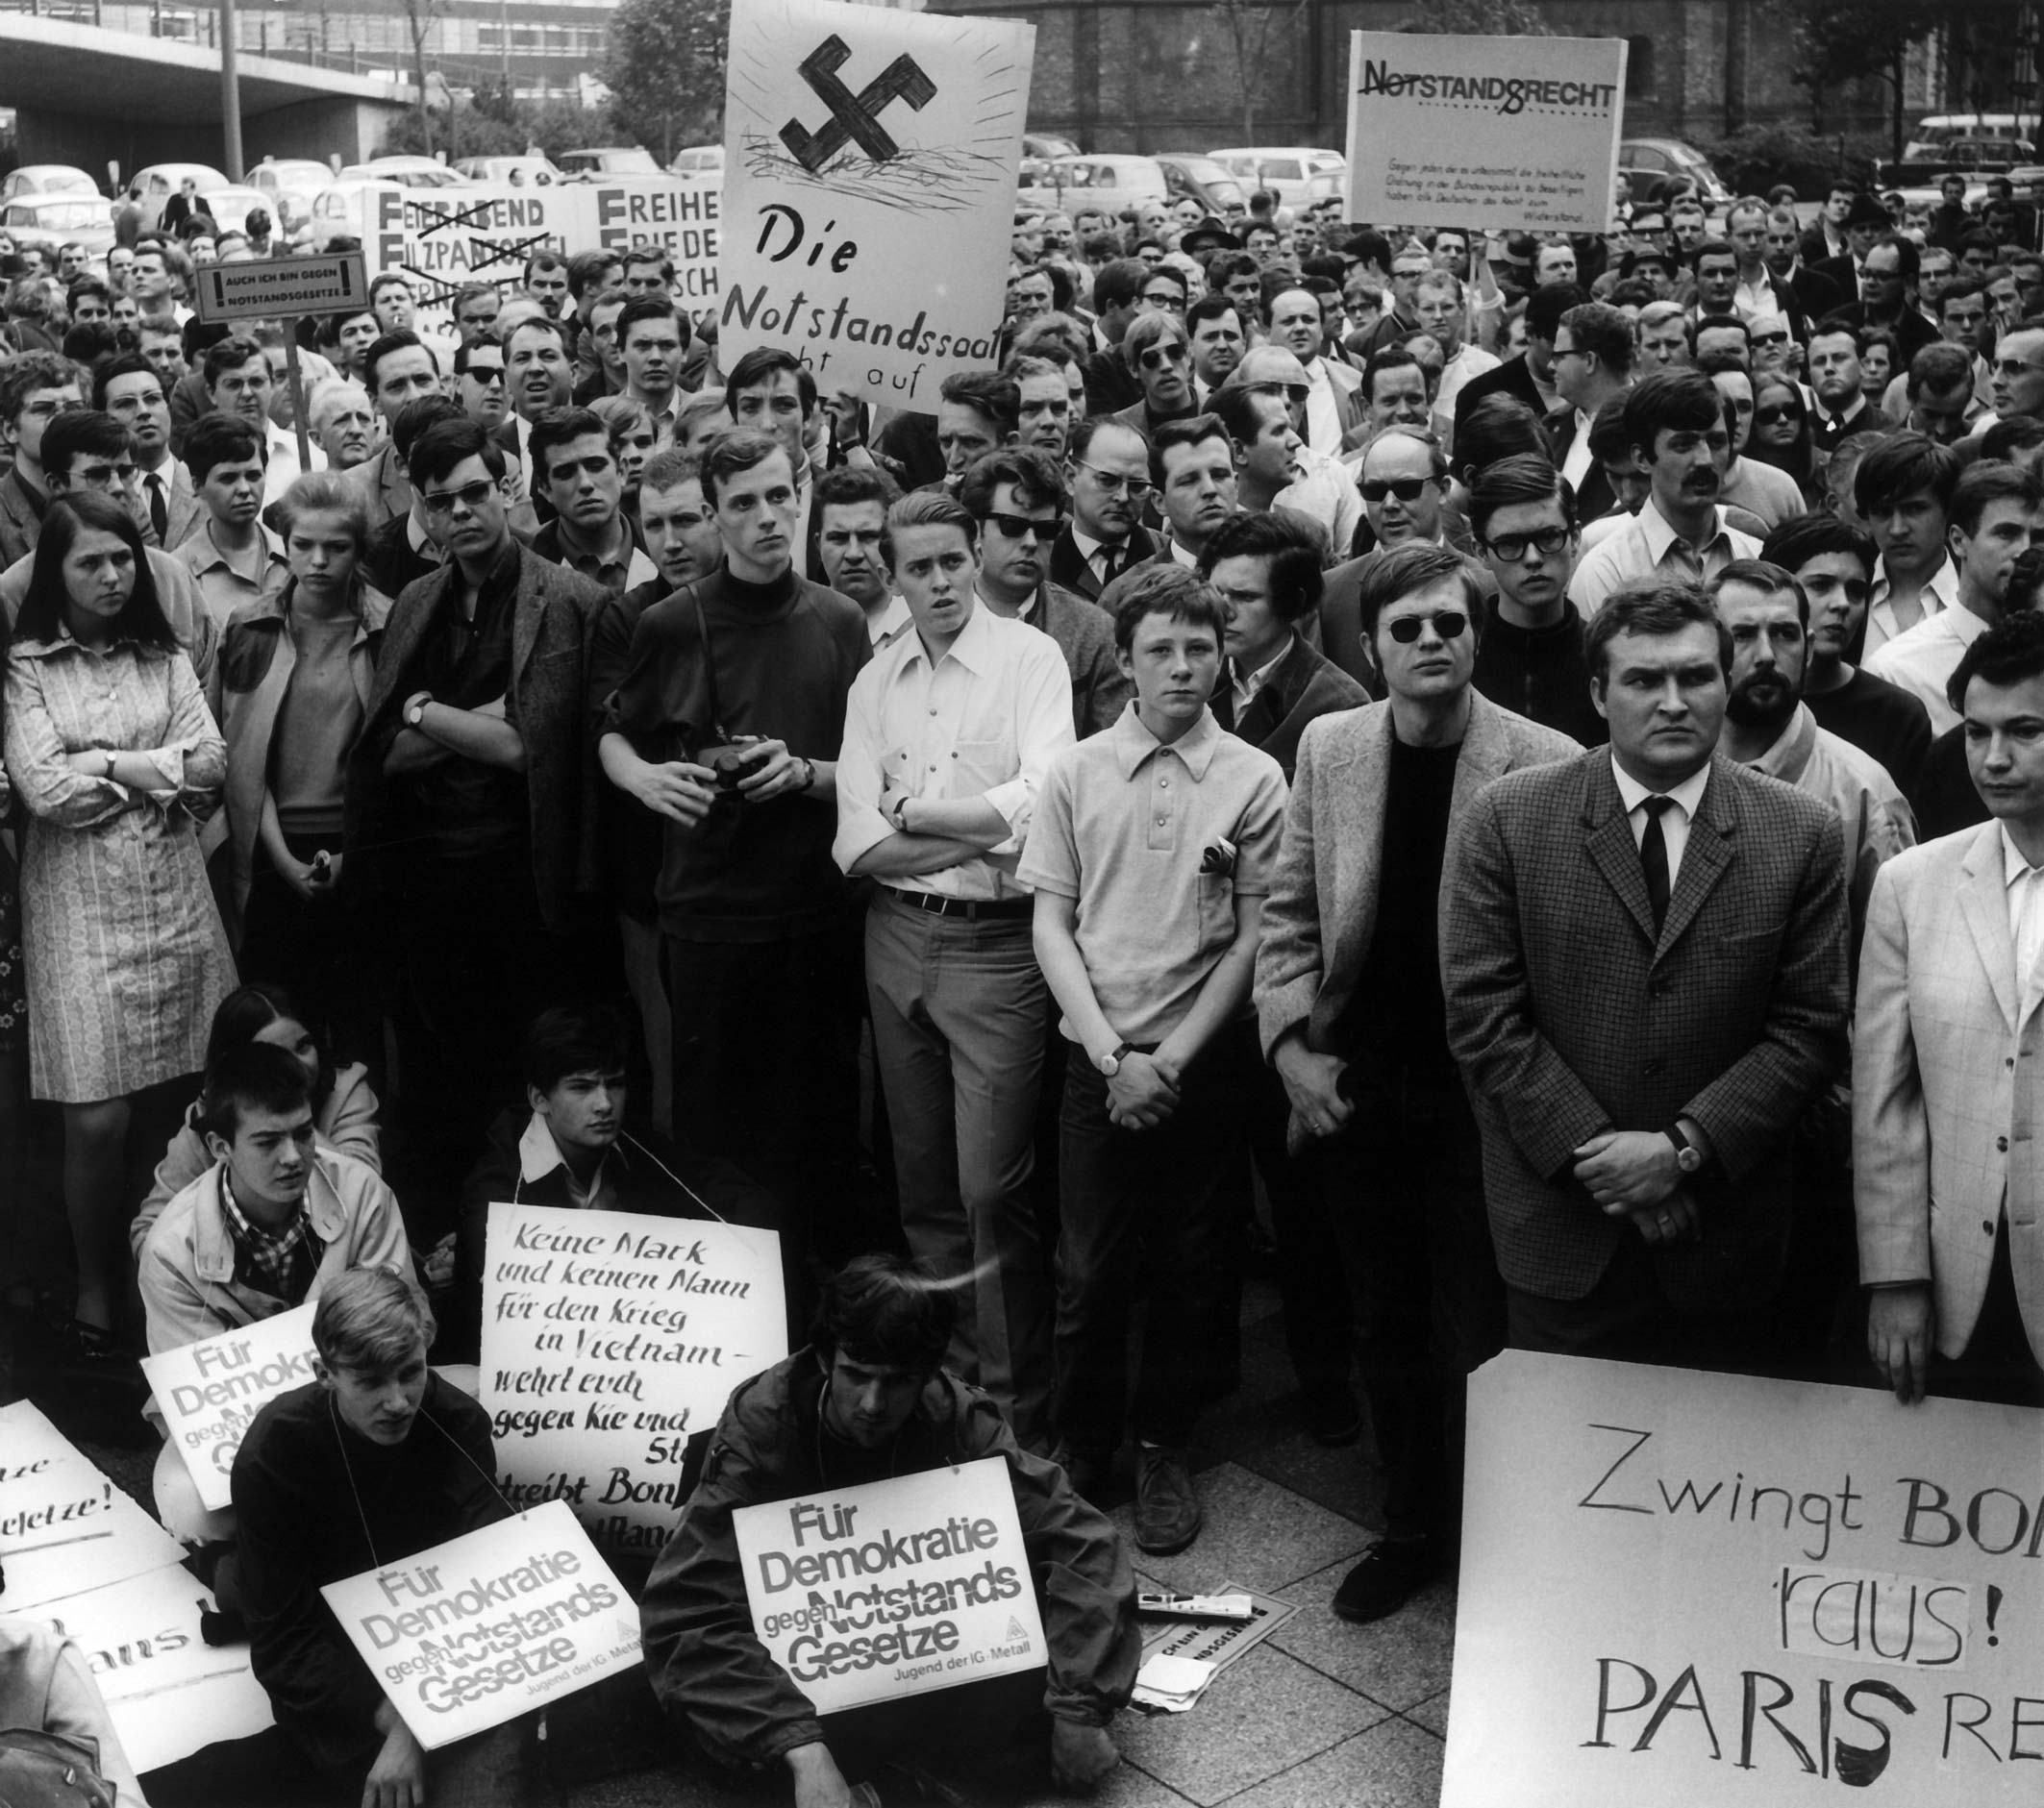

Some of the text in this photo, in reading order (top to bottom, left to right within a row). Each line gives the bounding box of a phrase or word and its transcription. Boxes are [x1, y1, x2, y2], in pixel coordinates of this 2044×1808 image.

[379, 192, 544, 230] FEIERABEND
[756, 204, 857, 273] Die
[226, 268, 337, 286] AUCH ICH BIN GEGEN
[228, 287, 340, 306] NOTSTANDSGESETZE
[867, 363, 926, 399] auf
[513, 1222, 708, 1265] Keine Mark
[495, 1259, 751, 1300] und keinen Mann
[544, 1295, 600, 1323] den
[608, 1298, 688, 1334] Krieg
[191, 1340, 252, 1378] Für
[534, 1324, 563, 1351] in
[575, 1327, 723, 1368] Vietnam
[493, 1365, 645, 1401] wehrt euch
[491, 1400, 691, 1439] gegen Kie und
[1578, 1423, 1862, 1562] Zwingt
[788, 1503, 858, 1548] Für
[758, 1517, 999, 1594] Demokratie
[359, 1549, 582, 1650] Demokratie
[374, 1564, 443, 1607] Für
[763, 1560, 1022, 1639] gegen Notstands
[384, 1582, 618, 1685] gegen Notstands
[787, 1620, 960, 1683] Gesetze
[417, 1636, 578, 1714] Gesetze
[524, 1670, 571, 1697] Jugend
[572, 1663, 593, 1678] der
[893, 1659, 943, 1681] Jugend
[946, 1654, 968, 1671] der
[1578, 1657, 2044, 1788] PARIS RE
